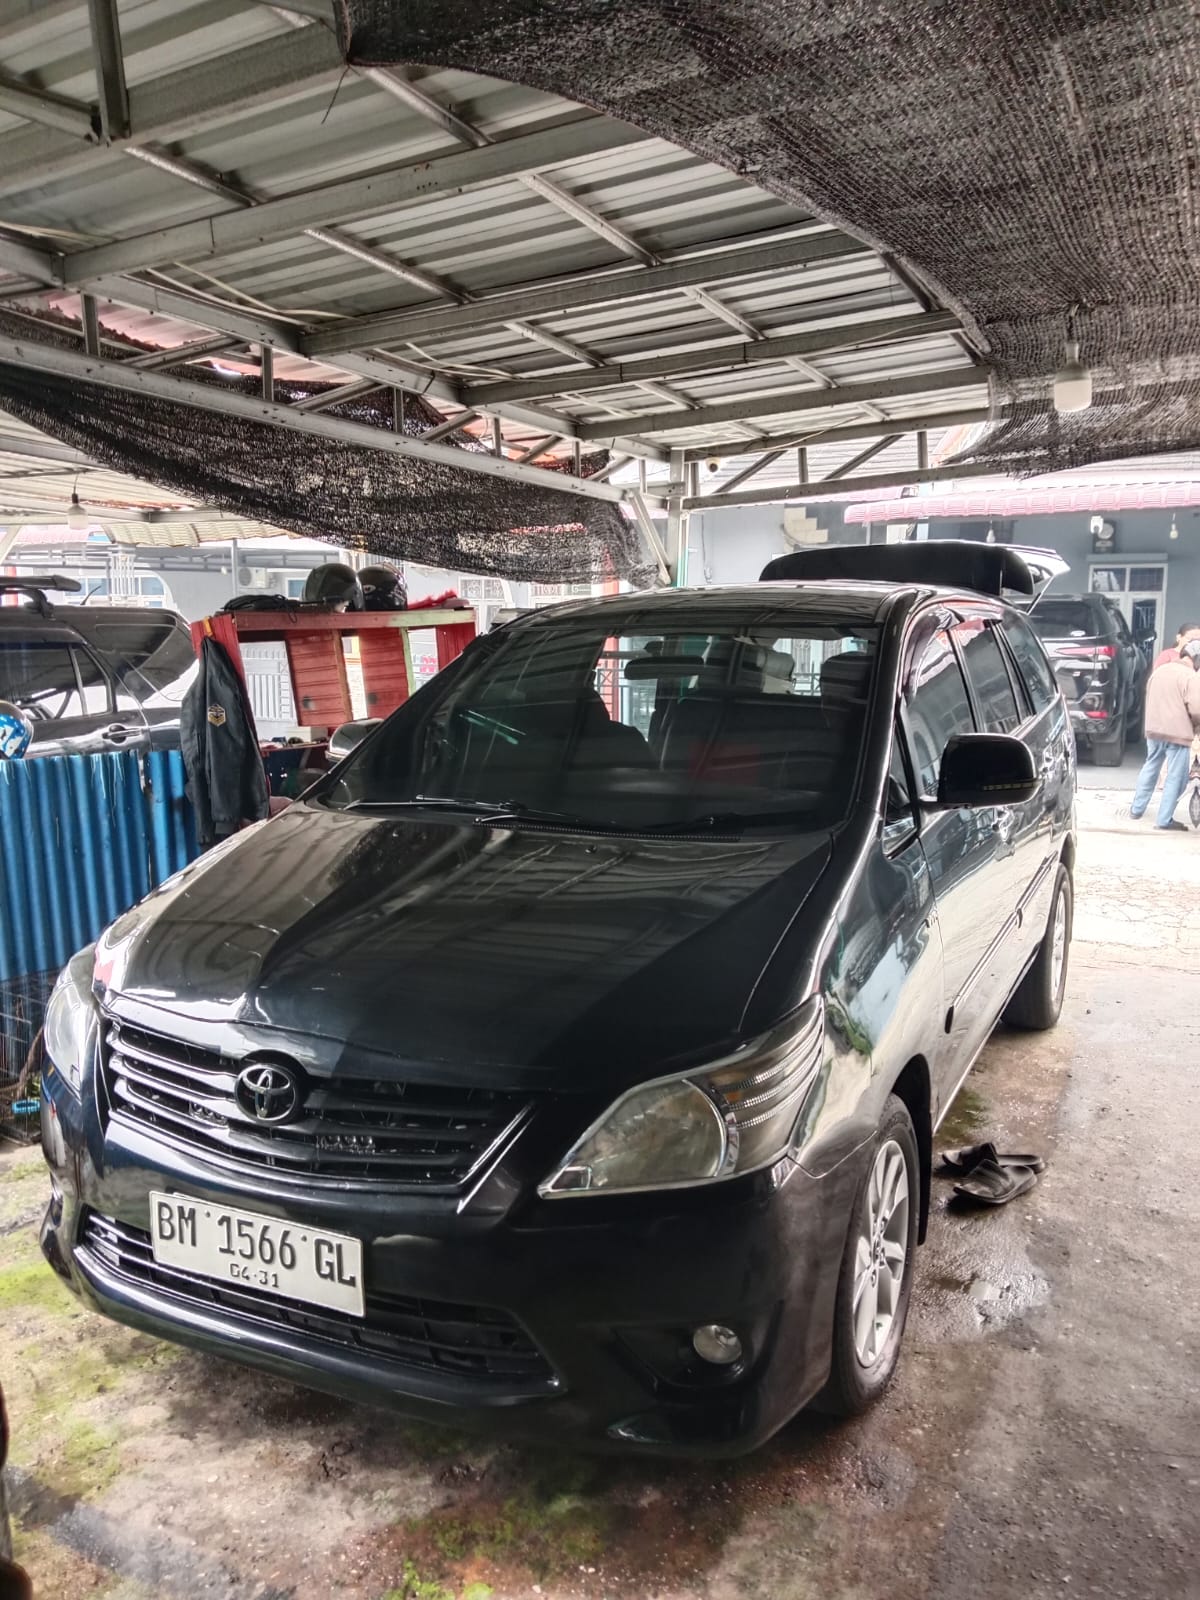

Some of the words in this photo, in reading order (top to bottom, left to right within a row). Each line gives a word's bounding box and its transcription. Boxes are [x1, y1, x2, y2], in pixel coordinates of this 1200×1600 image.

[157, 1202, 197, 1247] BM
[217, 1215, 296, 1270] 1566
[314, 1238, 357, 1288] GL
